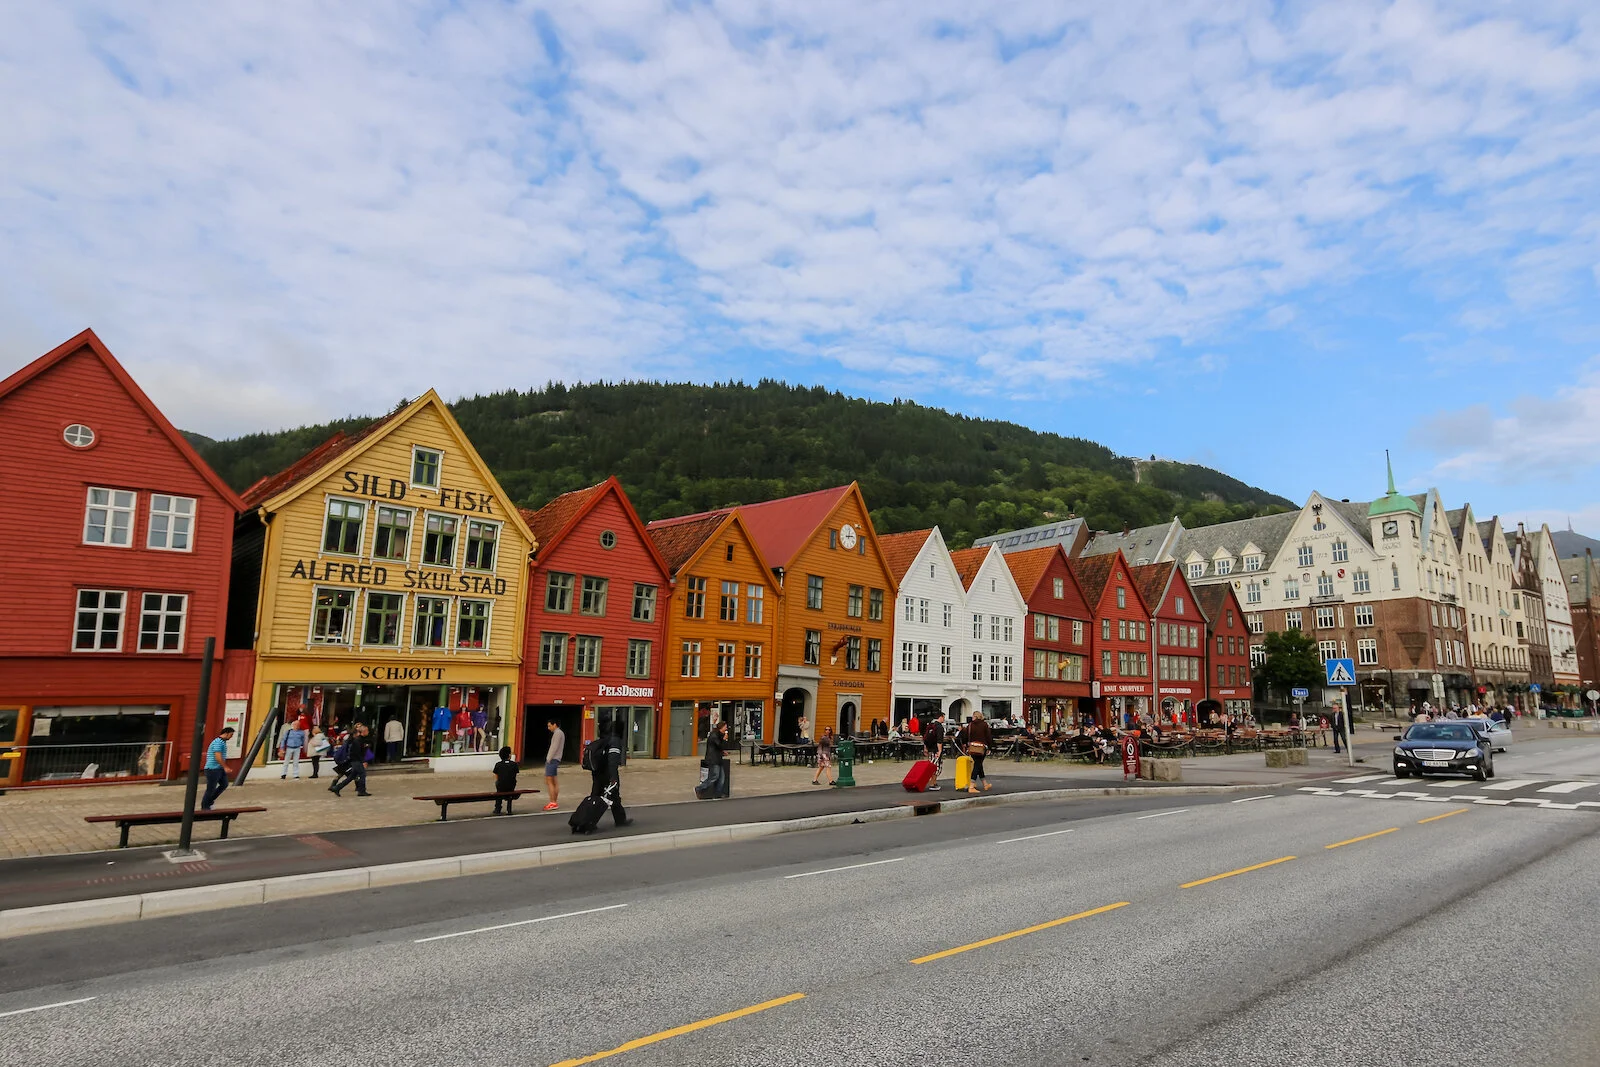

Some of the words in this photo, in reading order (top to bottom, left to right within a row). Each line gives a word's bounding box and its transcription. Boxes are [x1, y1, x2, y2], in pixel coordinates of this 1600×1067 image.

[342, 471, 407, 501] SILD
[439, 487, 495, 514] FISK
[290, 559, 387, 585] ALFRED
[404, 569, 507, 596] SKULSTAD
[360, 665, 446, 680] SCHJØTT
